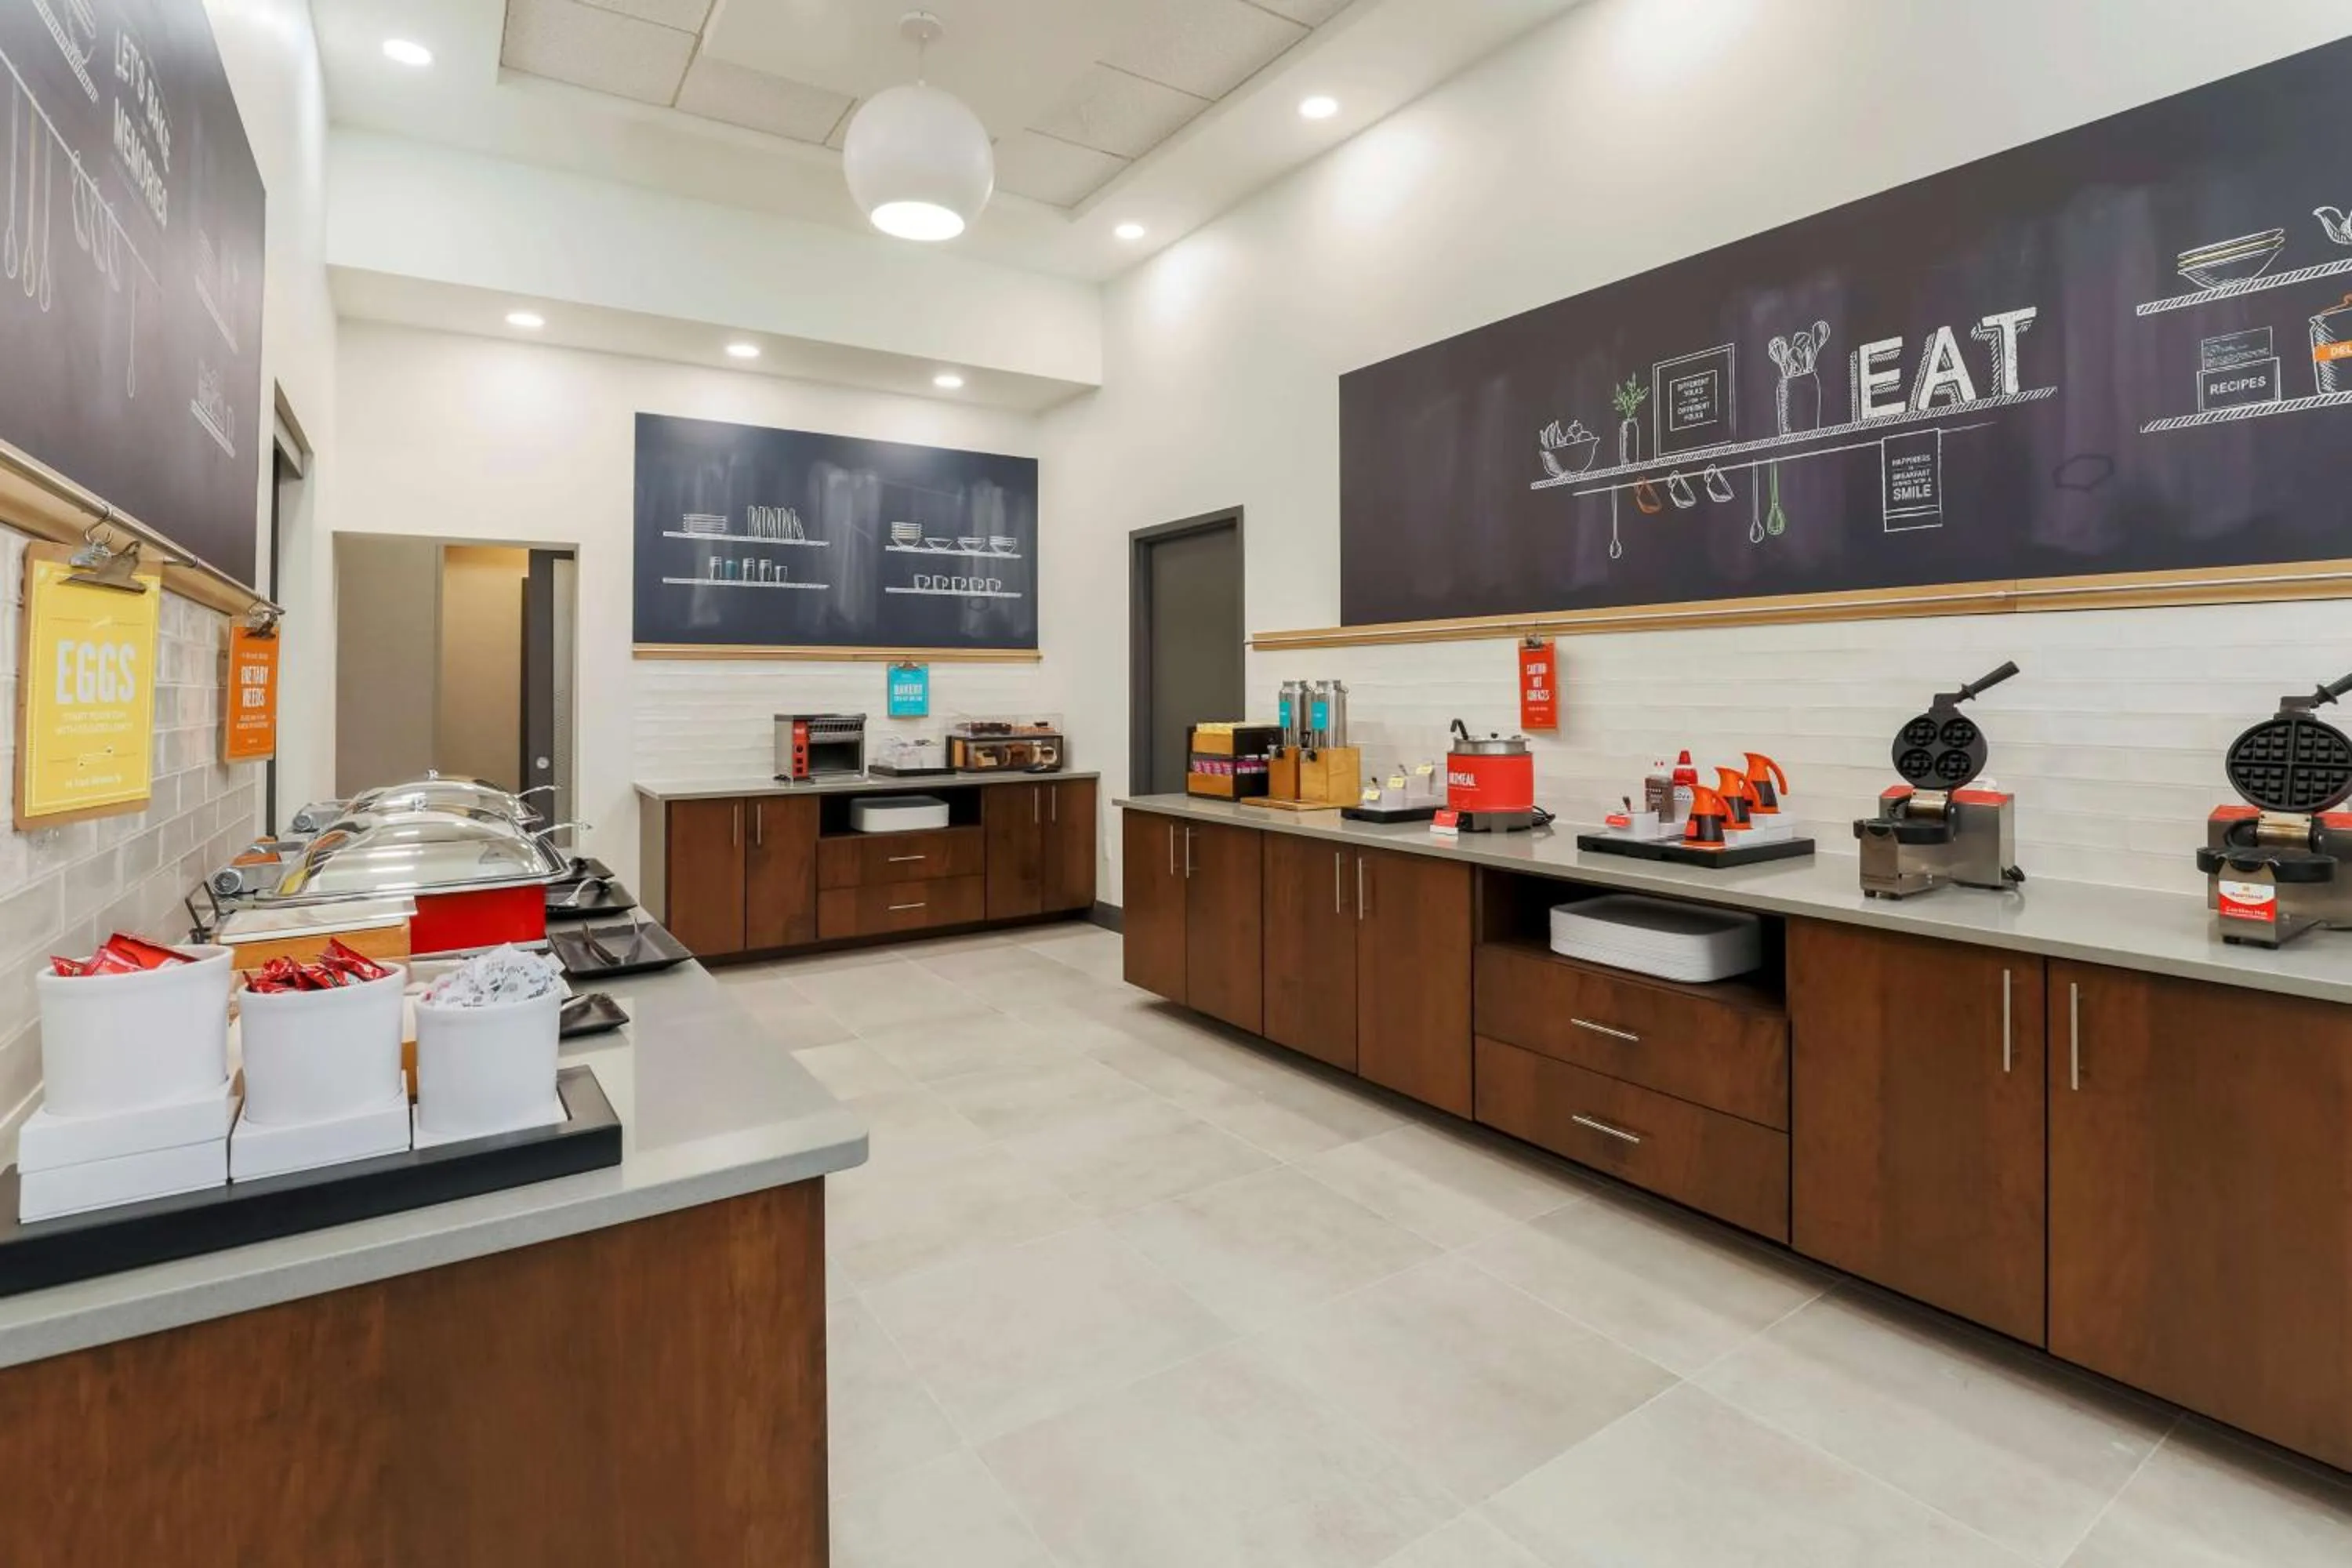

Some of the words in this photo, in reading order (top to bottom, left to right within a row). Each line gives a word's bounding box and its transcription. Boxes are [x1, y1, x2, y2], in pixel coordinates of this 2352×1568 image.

[114, 96, 168, 224] MEMORIES
[1852, 307, 2037, 423] EAT
[2209, 376, 2267, 395] RECIPES
[1893, 484, 1933, 501] SMILE
[56, 639, 137, 705] EGGS
